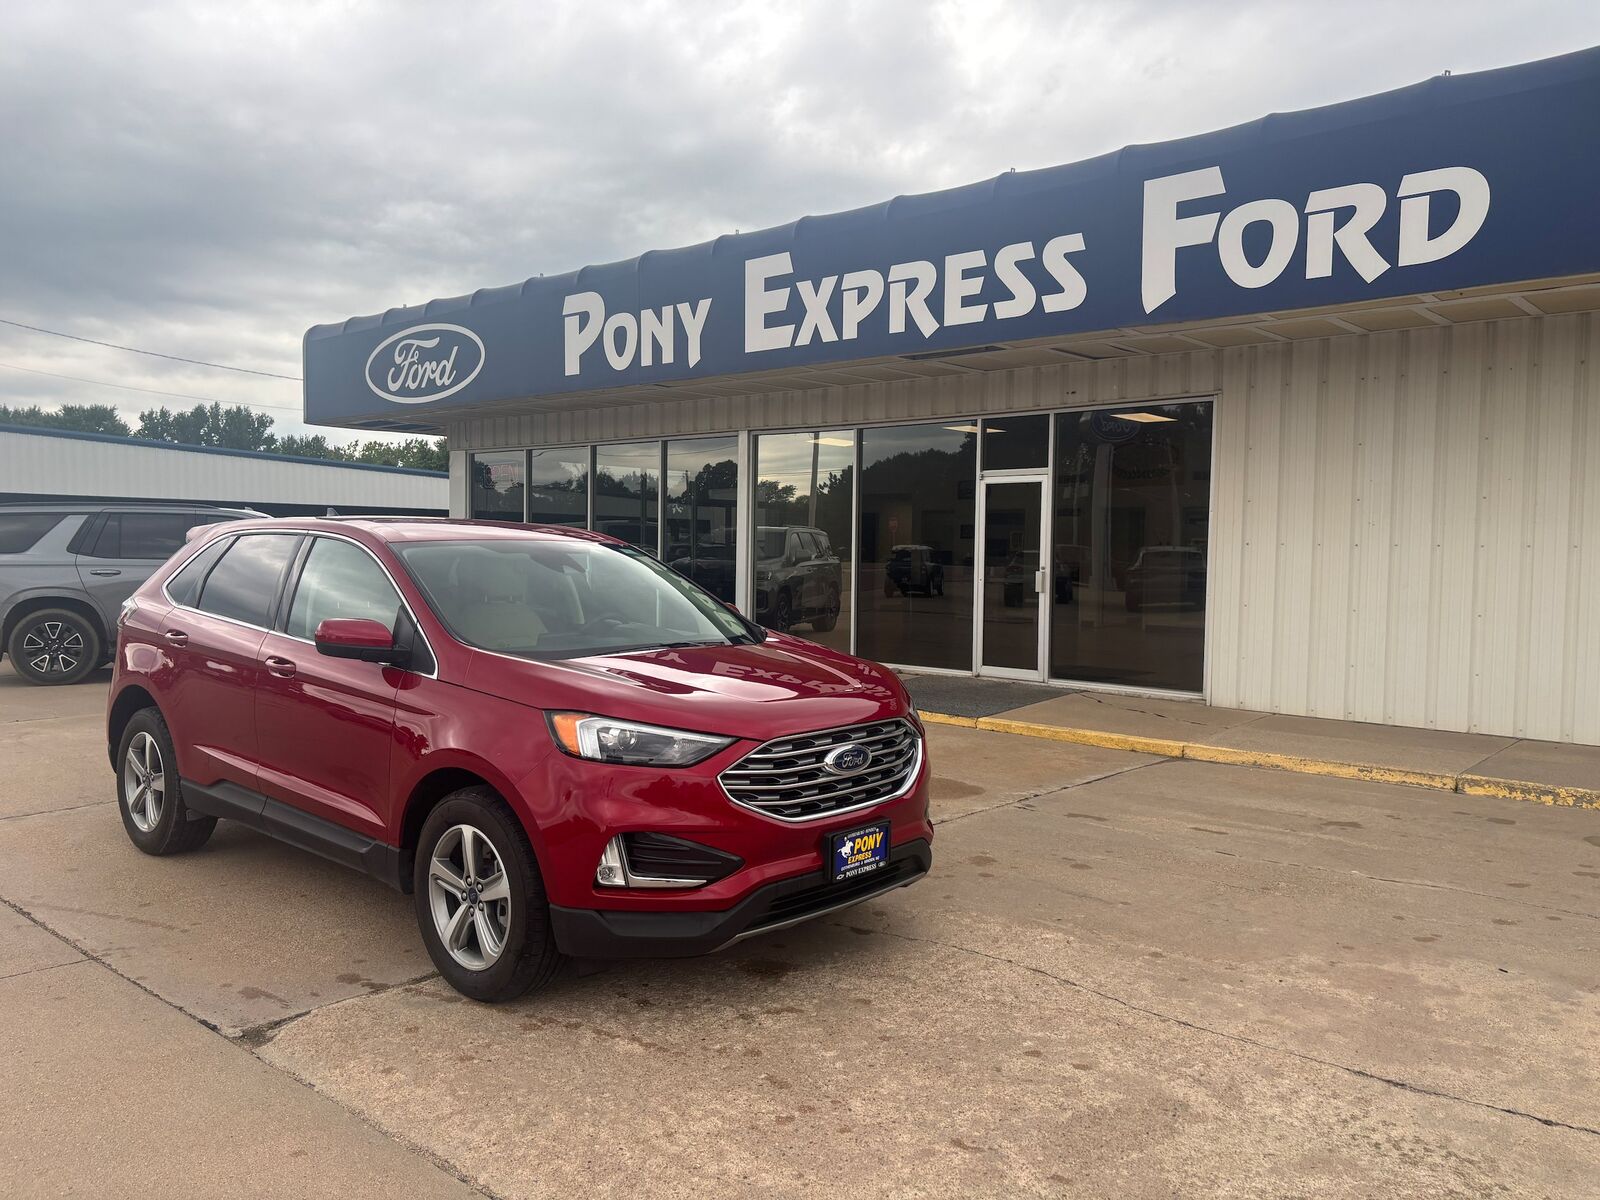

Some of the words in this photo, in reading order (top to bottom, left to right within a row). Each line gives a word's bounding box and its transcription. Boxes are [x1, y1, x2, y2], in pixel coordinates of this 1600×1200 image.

[563, 292, 712, 376] PONY
[744, 232, 1088, 354] EXPRESS
[1142, 166, 1490, 314] FORD
[387, 336, 459, 392] Ford
[841, 751, 864, 768] Ford
[853, 832, 884, 855] PONY
[848, 851, 872, 864] EXPRESS
[846, 869, 858, 878] PONY
[858, 863, 877, 874] EXPRESS
